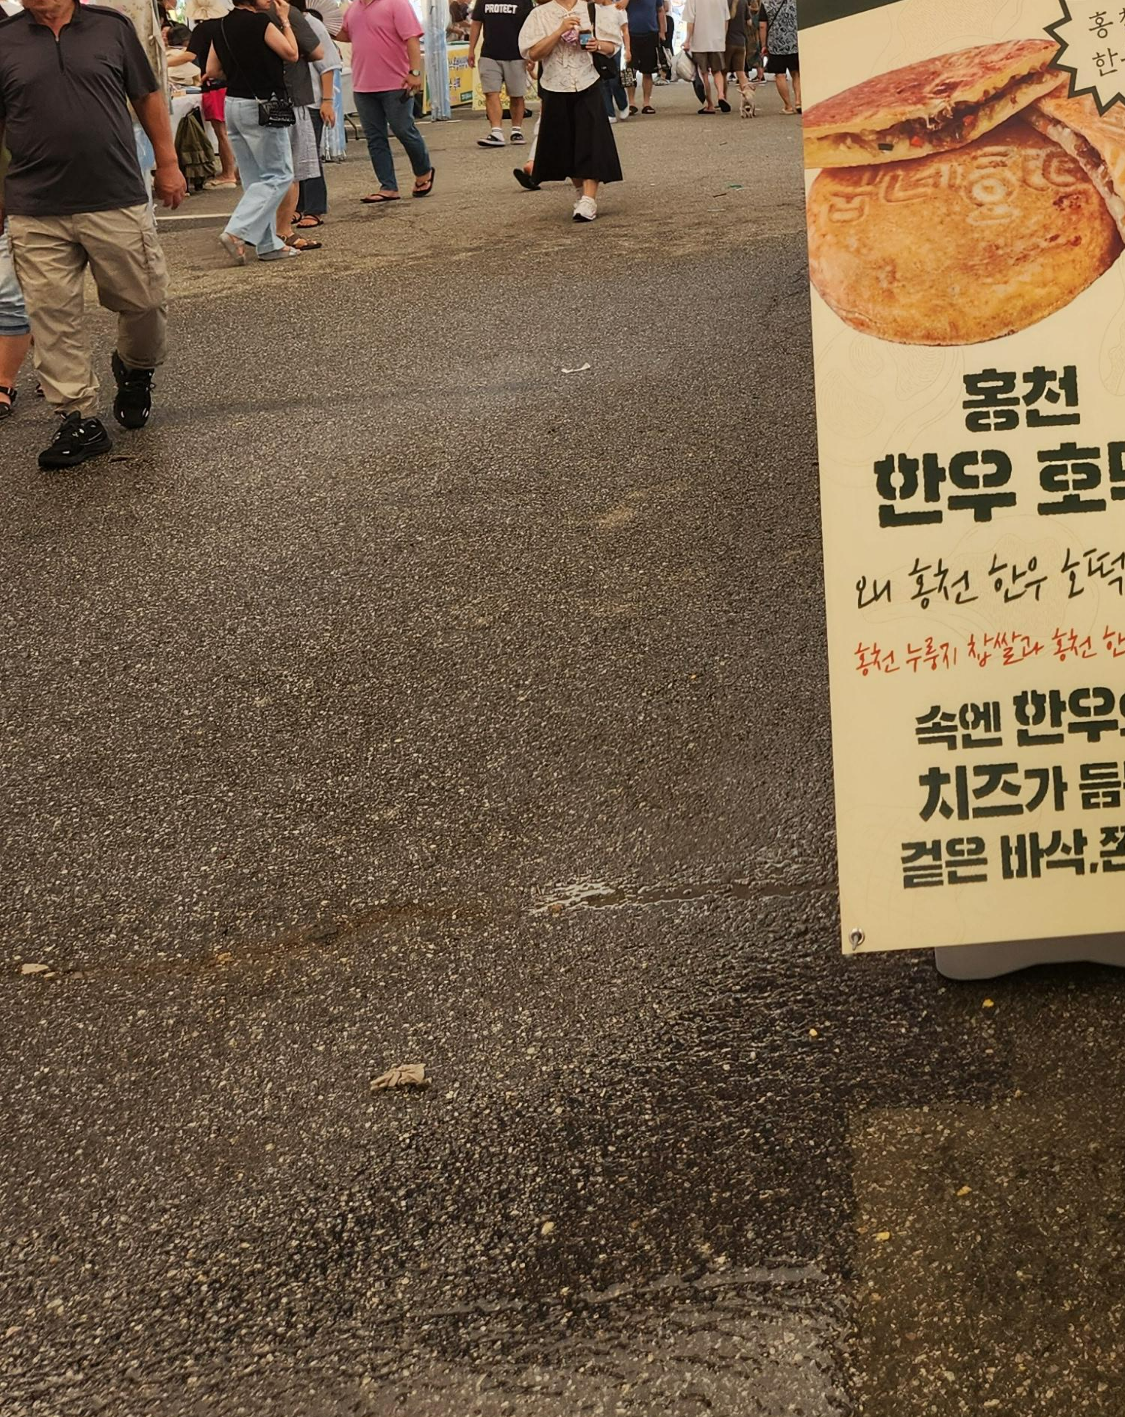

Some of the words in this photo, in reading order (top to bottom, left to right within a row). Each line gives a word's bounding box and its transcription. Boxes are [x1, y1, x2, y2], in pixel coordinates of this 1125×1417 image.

[484, 3, 518, 16] PROTECT
[962, 365, 1081, 433] 홍천
[873, 448, 1017, 529] 한우
[855, 575, 892, 610] 왜
[908, 557, 979, 610] 홍천
[987, 552, 1049, 604] 한우
[853, 640, 901, 677] 홍천
[904, 635, 959, 673] 누룽지
[966, 631, 1045, 667] 찹쌀과
[1051, 627, 1098, 661] 홍천
[914, 701, 1003, 751] 속엔
[918, 762, 1068, 822] 치즈가
[901, 836, 988, 889] 겉은
